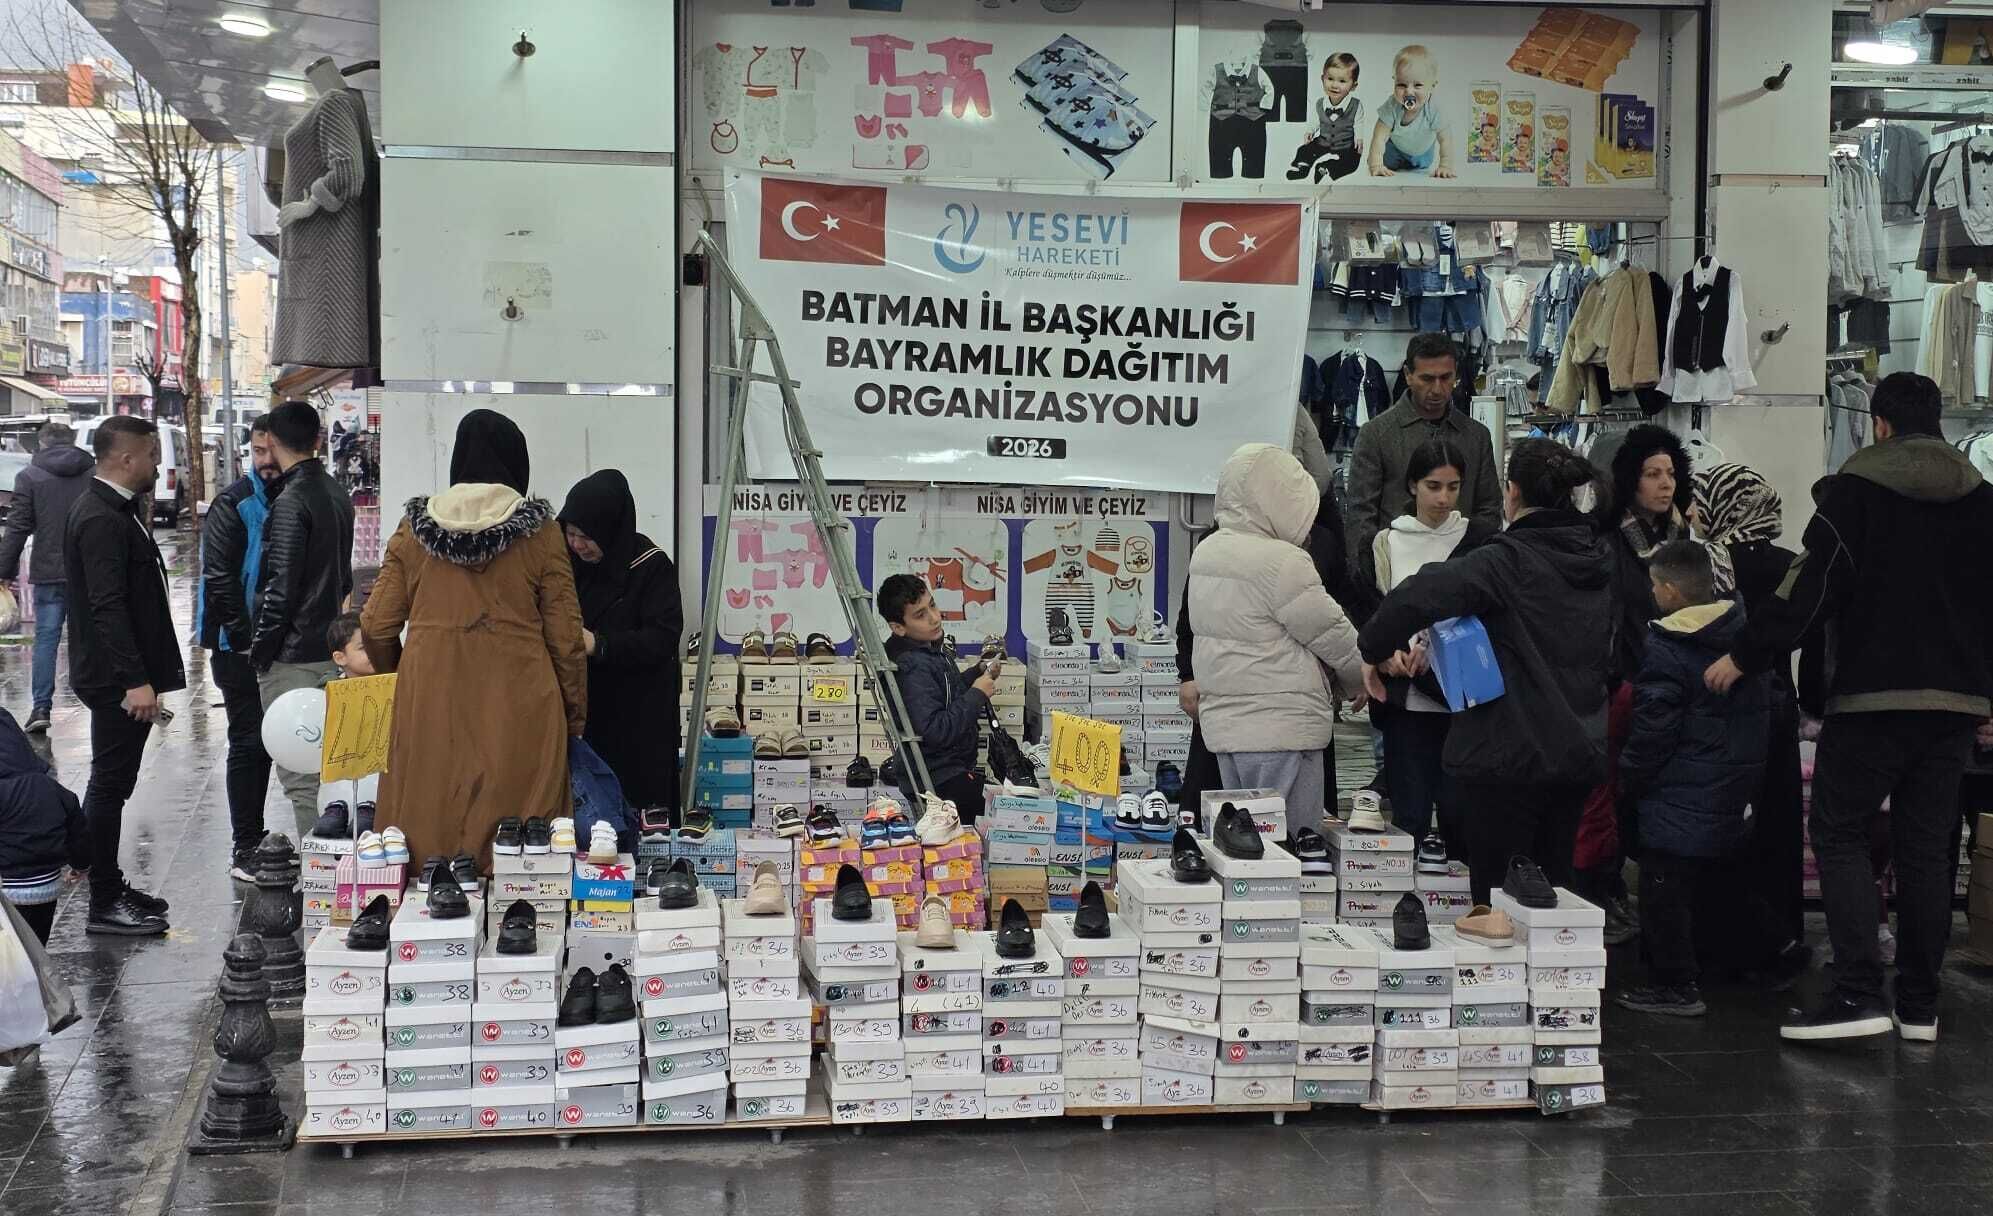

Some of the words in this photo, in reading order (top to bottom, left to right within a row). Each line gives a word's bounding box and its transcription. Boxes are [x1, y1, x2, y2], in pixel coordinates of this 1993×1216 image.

[1007, 209, 1129, 244] YESEVİ
[1018, 246, 1119, 265] HAREKETİ
[1043, 268, 1084, 280] düşmektir
[801, 290, 970, 331] BATMAN
[980, 290, 1011, 332] İL
[1022, 300, 1255, 344] BAŞKANLIĞI
[826, 336, 1052, 379] BAYRAMLIK
[1063, 342, 1228, 385] DAĞITIM
[854, 380, 1199, 427] ORGANİZASYONU
[1001, 438, 1052, 457] 2026
[733, 488, 772, 512] NİSA
[831, 494, 852, 512] VE
[858, 490, 906, 516] ÇEYİZ
[977, 492, 1015, 513] NİSA
[1021, 492, 1067, 515] GİYİM
[1073, 496, 1093, 515] VE
[1099, 493, 1146, 519] ÇEYİZ
[816, 687, 843, 698] 280
[1055, 725, 1110, 782] 400
[444, 944, 467, 957] 38
[1111, 961, 1130, 974] 36
[333, 981, 358, 993] Ayzen
[442, 984, 470, 1002] 38
[1036, 986, 1056, 997] 40
[1110, 1004, 1128, 1018] 36
[1112, 1042, 1128, 1055] 36
[332, 1072, 356, 1083] Ayzen
[525, 1066, 548, 1081] 39
[1039, 1081, 1059, 1095] 40
[1111, 1088, 1131, 1100] 36
[527, 1110, 546, 1124] 40
[692, 1105, 715, 1119] 36
[333, 1117, 359, 1128] Ayzen
